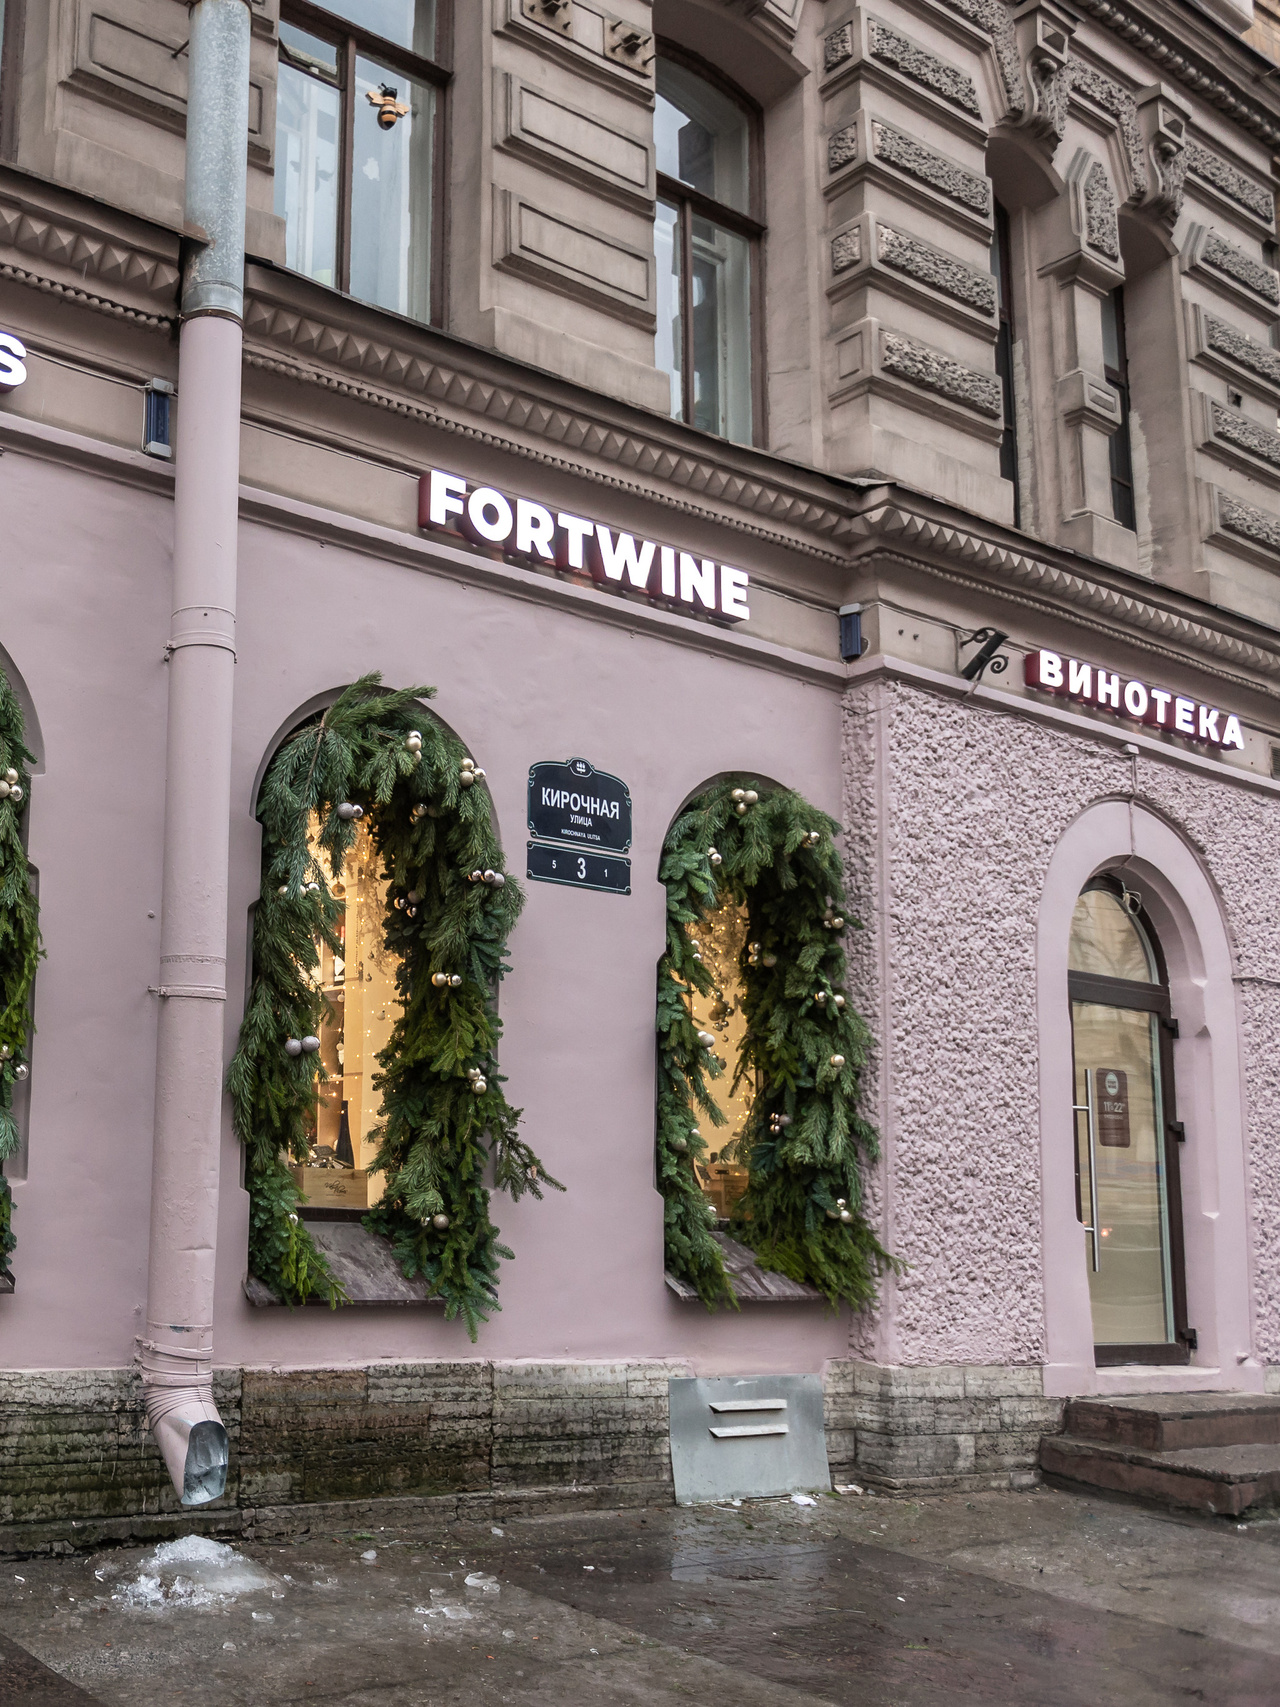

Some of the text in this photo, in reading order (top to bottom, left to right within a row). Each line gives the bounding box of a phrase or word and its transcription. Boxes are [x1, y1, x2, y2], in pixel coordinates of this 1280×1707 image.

[426, 469, 751, 622] FORTWINE
[1037, 649, 1245, 750] ВИНОТЕКА
[542, 787, 620, 819] КИРОЧНАЯ
[570, 814, 593, 827] УЛИЦА
[552, 857, 608, 879] 5 3 1
